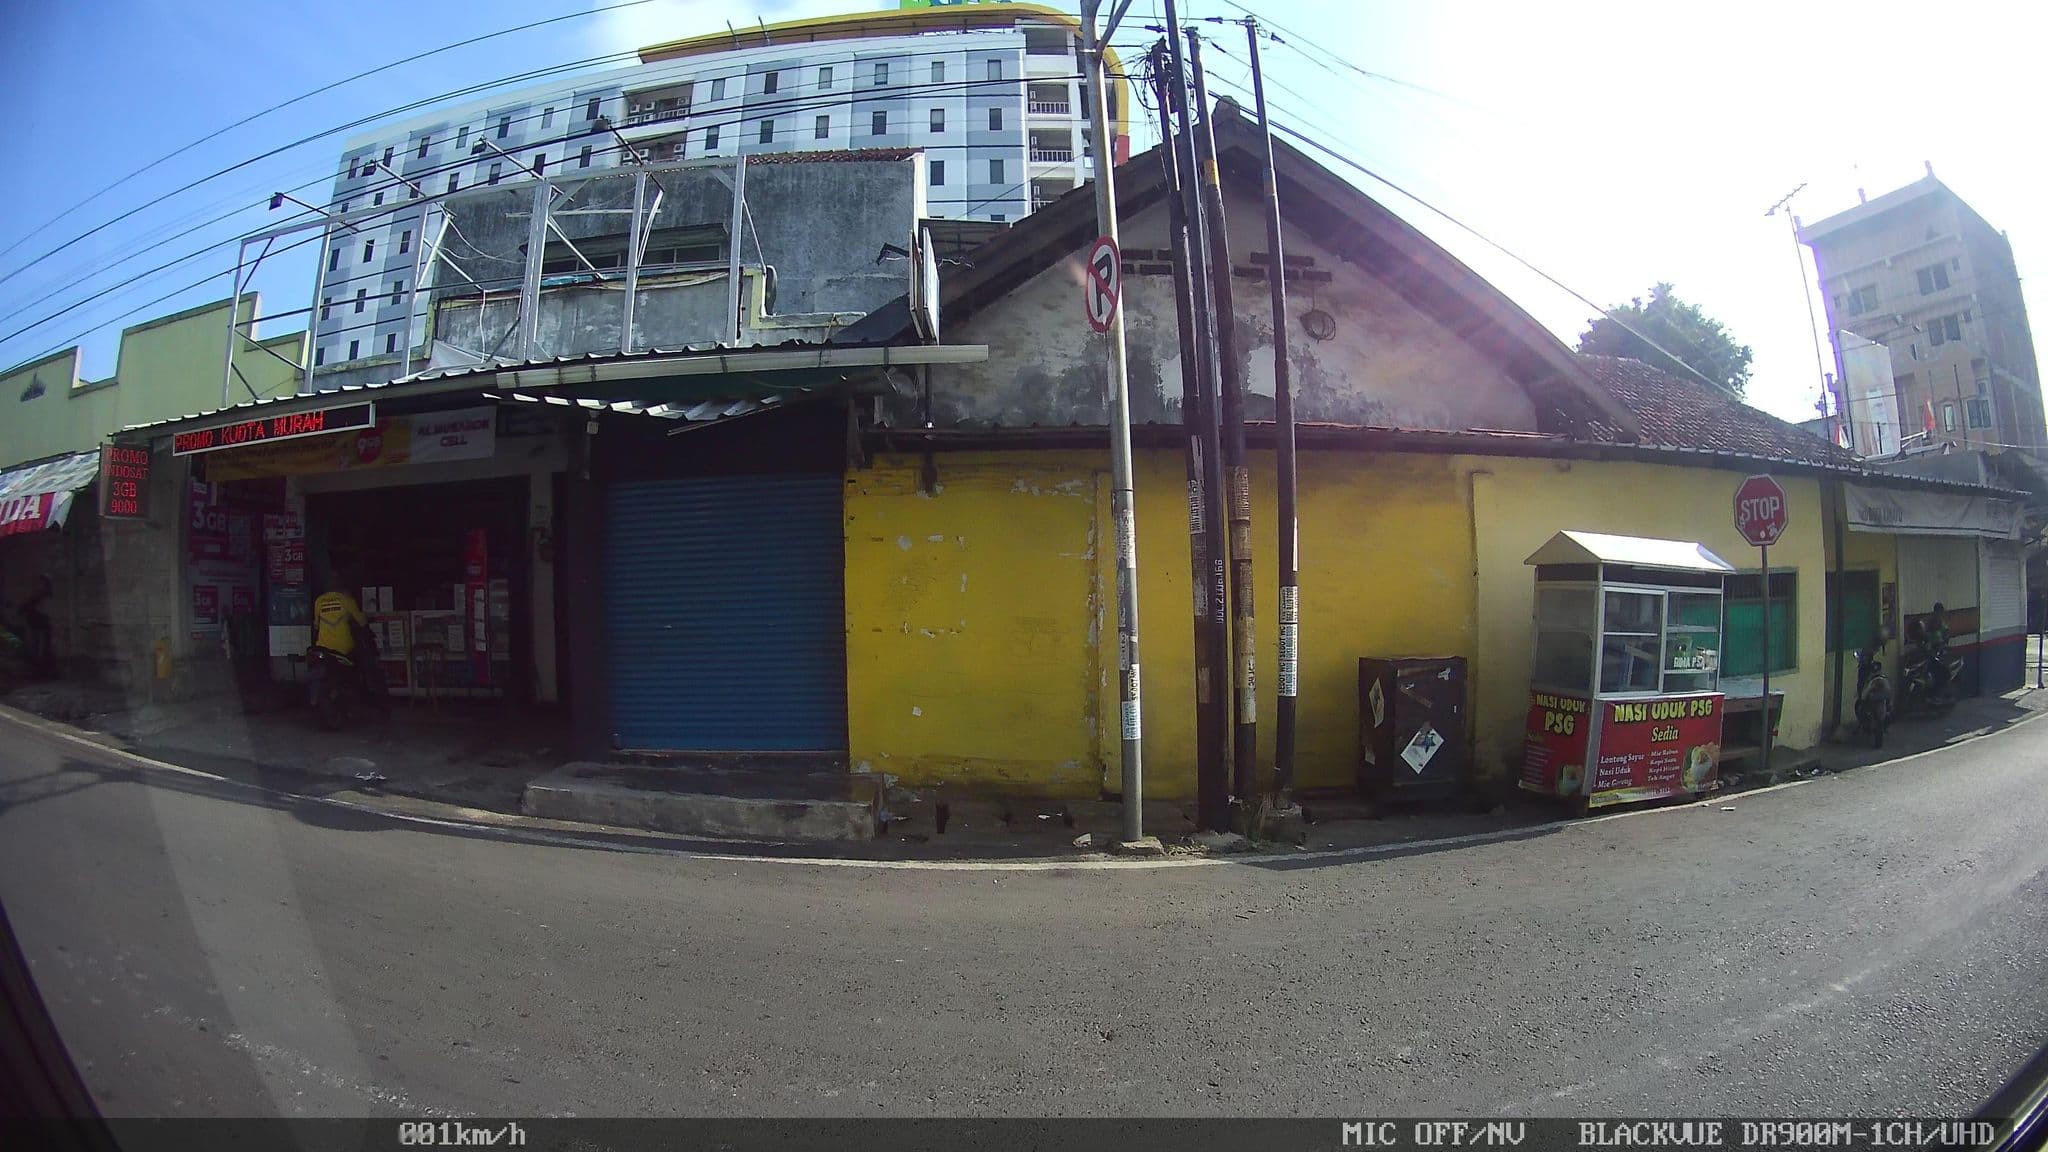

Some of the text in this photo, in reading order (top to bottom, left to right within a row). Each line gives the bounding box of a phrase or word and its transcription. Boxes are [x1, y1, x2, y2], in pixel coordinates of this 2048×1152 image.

[175, 410, 325, 452] PROMO KUOTA MURAH
[105, 447, 148, 464] PROMO
[112, 481, 137, 497] 3GB
[1741, 496, 1780, 522] STOP
[1536, 693, 1585, 712] NASI UDUK
[1614, 699, 1713, 723] NASI UDUK PSG
[1544, 711, 1575, 736] PSG
[1651, 725, 1679, 742] Sedia
[1599, 765, 1632, 777] Nasi Uduk
